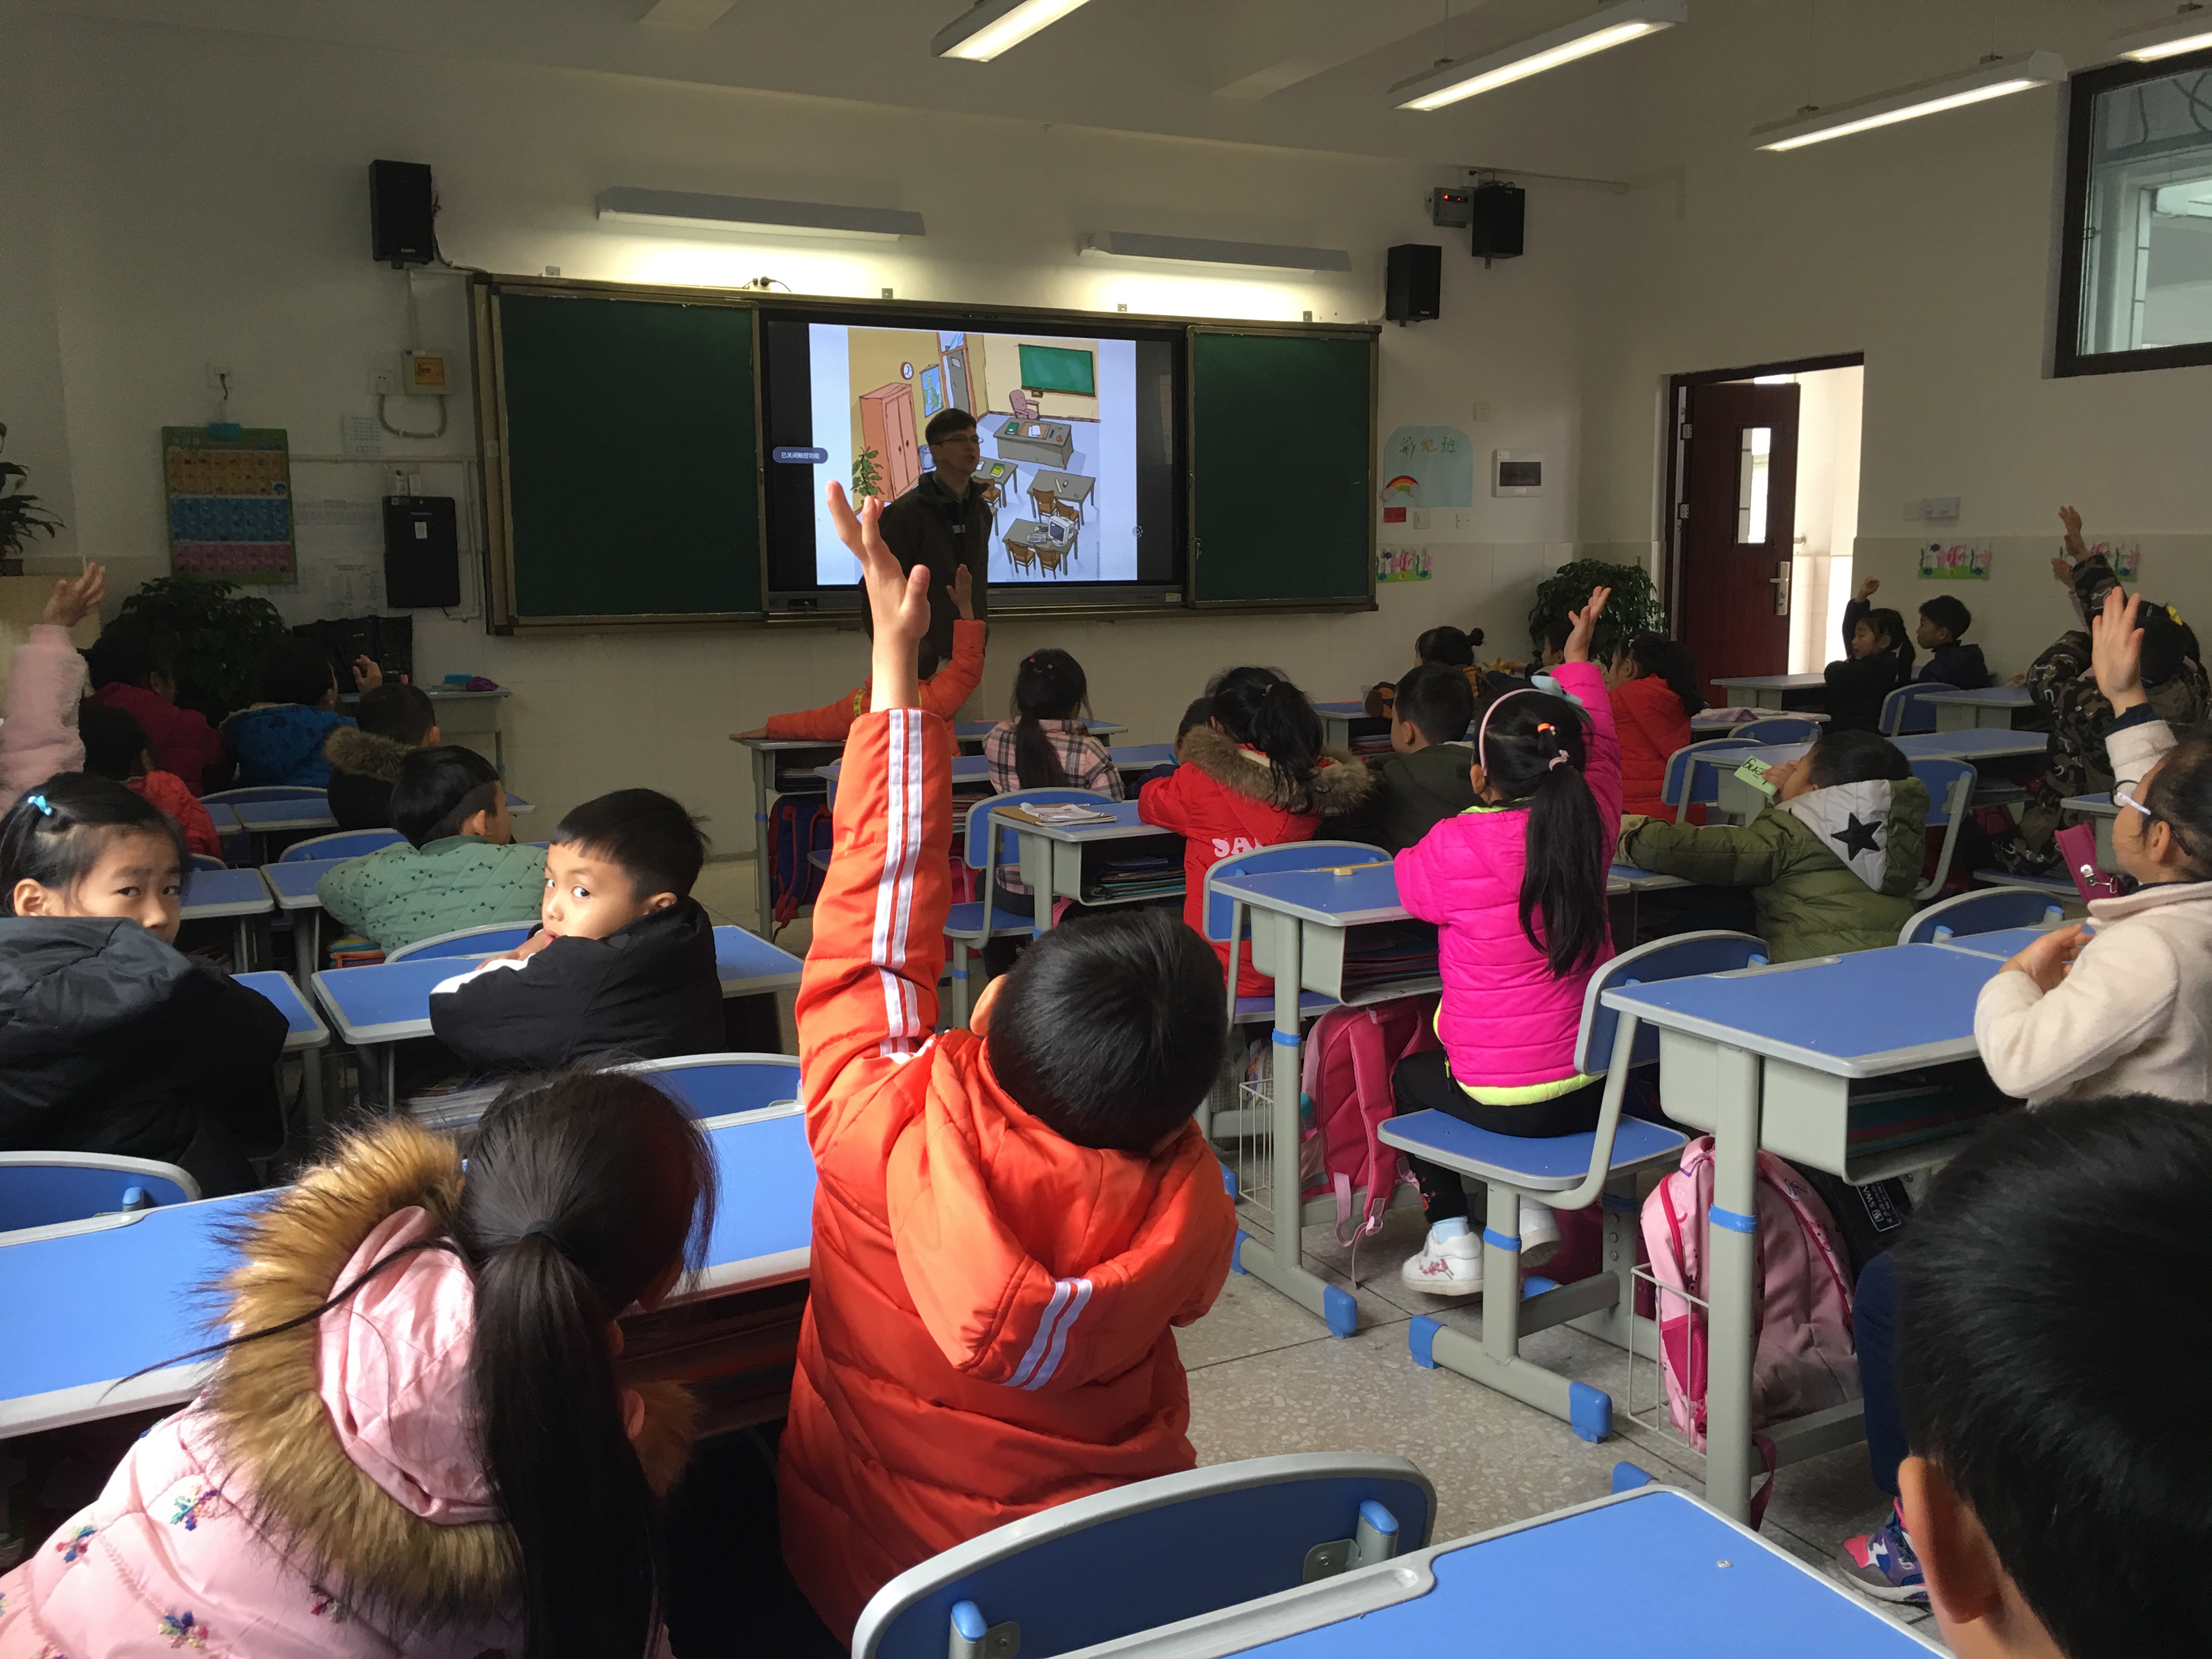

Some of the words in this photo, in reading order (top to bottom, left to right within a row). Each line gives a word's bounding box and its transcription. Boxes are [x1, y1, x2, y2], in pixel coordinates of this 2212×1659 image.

[1399, 437, 1456, 459] 彩虹班
[1742, 758, 1768, 785] ēng
[1212, 837, 1263, 857] SA
